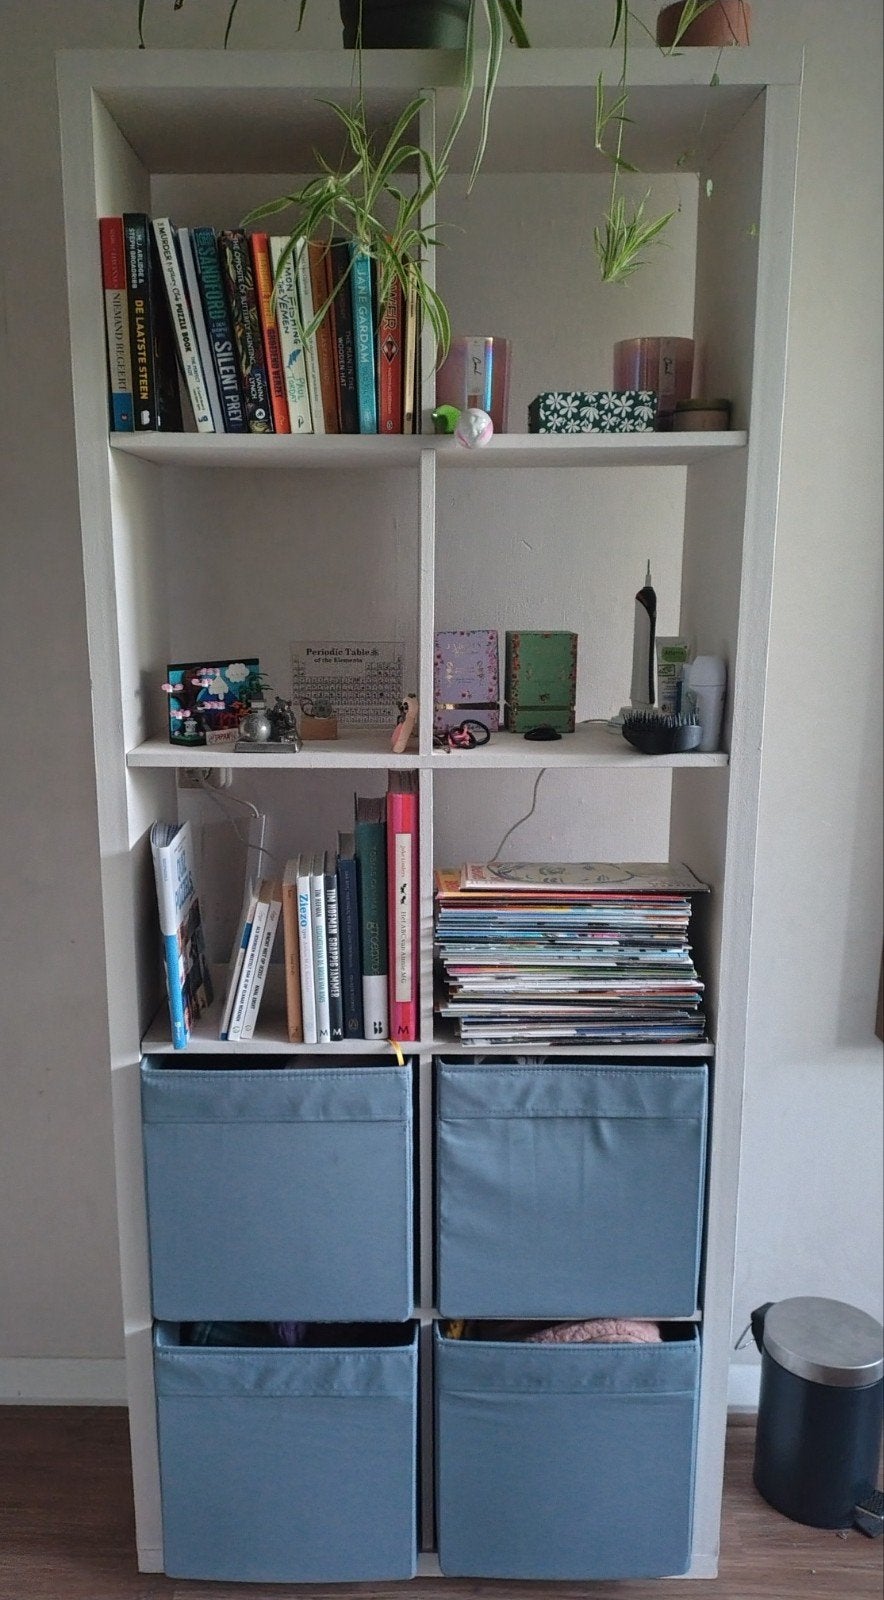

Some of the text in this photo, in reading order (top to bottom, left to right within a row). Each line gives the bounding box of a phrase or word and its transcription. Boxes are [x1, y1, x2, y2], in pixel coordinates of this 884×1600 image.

[157, 225, 171, 262] MURDER
[198, 246, 228, 324] SANDFORD
[112, 292, 123, 340] NIEMAND
[175, 303, 188, 330] PUZZLE
[278, 290, 291, 334] YEMEN
[357, 269, 369, 363] JANE GARDAM
[134, 300, 149, 400] DE LAATSTE STEEN
[181, 330, 193, 353] BOOK
[245, 334, 256, 365] HUNTING
[337, 336, 345, 370] WOODEN
[214, 341, 237, 390] SILENT
[226, 389, 243, 422] PREY
[249, 376, 257, 400] LYNCH
[254, 371, 265, 402] EVANNA
[295, 376, 306, 400] PAUL
[306, 647, 370, 657] Periodic Table
[298, 893, 309, 928] Ziezo
[327, 889, 342, 998] TIM HOFMAN GRAPPIG JAMMER
[332, 1028, 342, 1036] M
[397, 1026, 410, 1035] M
